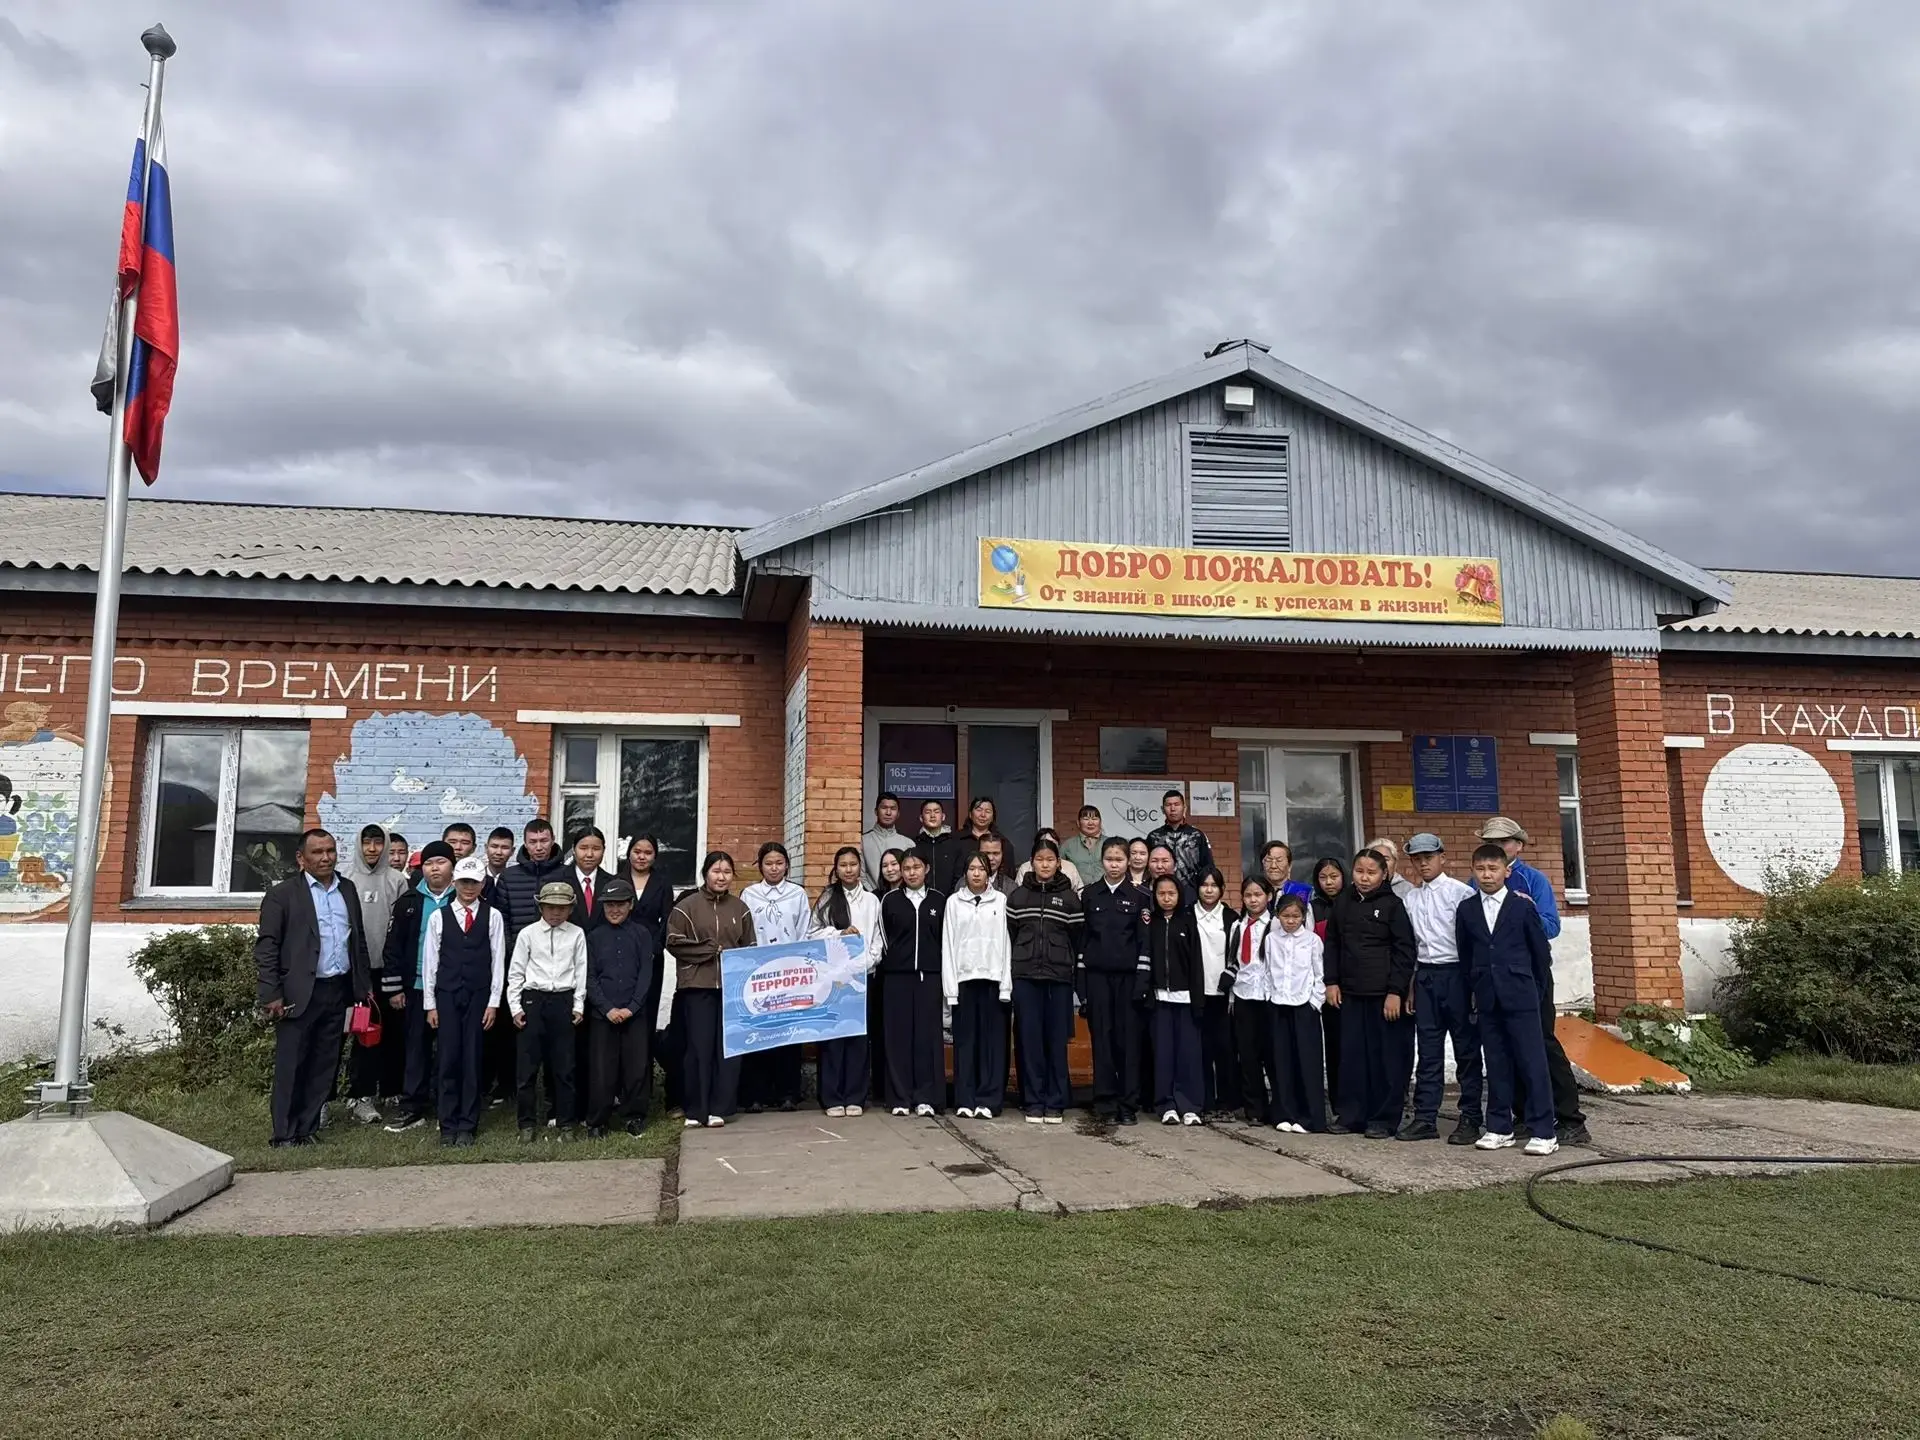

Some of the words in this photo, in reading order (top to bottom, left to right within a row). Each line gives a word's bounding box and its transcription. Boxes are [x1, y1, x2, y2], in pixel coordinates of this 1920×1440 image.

[1056, 549, 1172, 580] ДОБРО
[1184, 554, 1433, 589] ПОЖАЛОВАТЬ!
[1040, 584, 1067, 602] От
[1073, 588, 1147, 606] знаний
[1153, 593, 1165, 606] в
[1172, 592, 1236, 608] школе
[1255, 595, 1269, 609] к
[1274, 596, 1352, 612] успехам
[1360, 598, 1371, 612] в
[1378, 598, 1449, 615] жизни!
[191, 658, 498, 703] ВРЕМЕНИ
[1706, 693, 1735, 735] В
[889, 767, 907, 778] 165
[751, 970, 781, 981] ВМЕСТЕ
[783, 967, 814, 976] ПРОТИВ
[751, 975, 814, 993] ТЕРРОРА!
